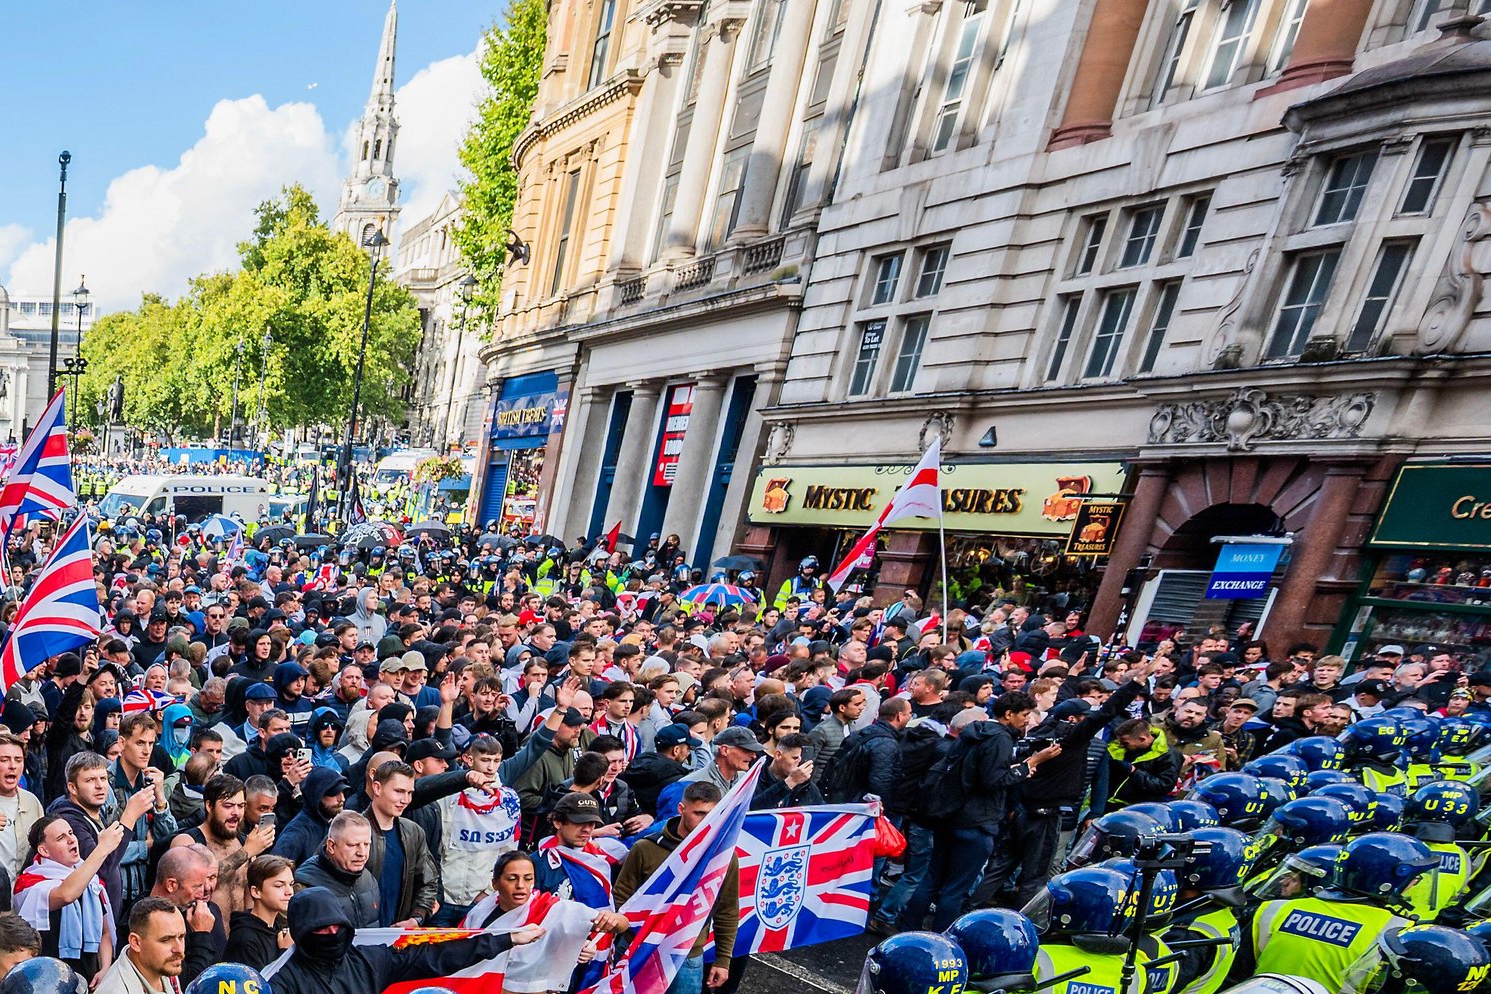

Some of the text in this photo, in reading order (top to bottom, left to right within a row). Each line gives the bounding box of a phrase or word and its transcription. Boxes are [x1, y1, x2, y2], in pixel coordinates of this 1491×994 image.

[802, 485, 1026, 512] MYSTIC SURES
[1089, 505, 1114, 515] MYSTIC
[1073, 542, 1106, 551] TREASURES
[1230, 554, 1265, 562] MONEY
[1212, 581, 1266, 590] EXCHANGE
[1378, 727, 1395, 735] EG
[1439, 855, 1459, 871] LICE
[1284, 913, 1356, 943] POLICE
[933, 959, 963, 968] 1993
[938, 970, 959, 982] MP
